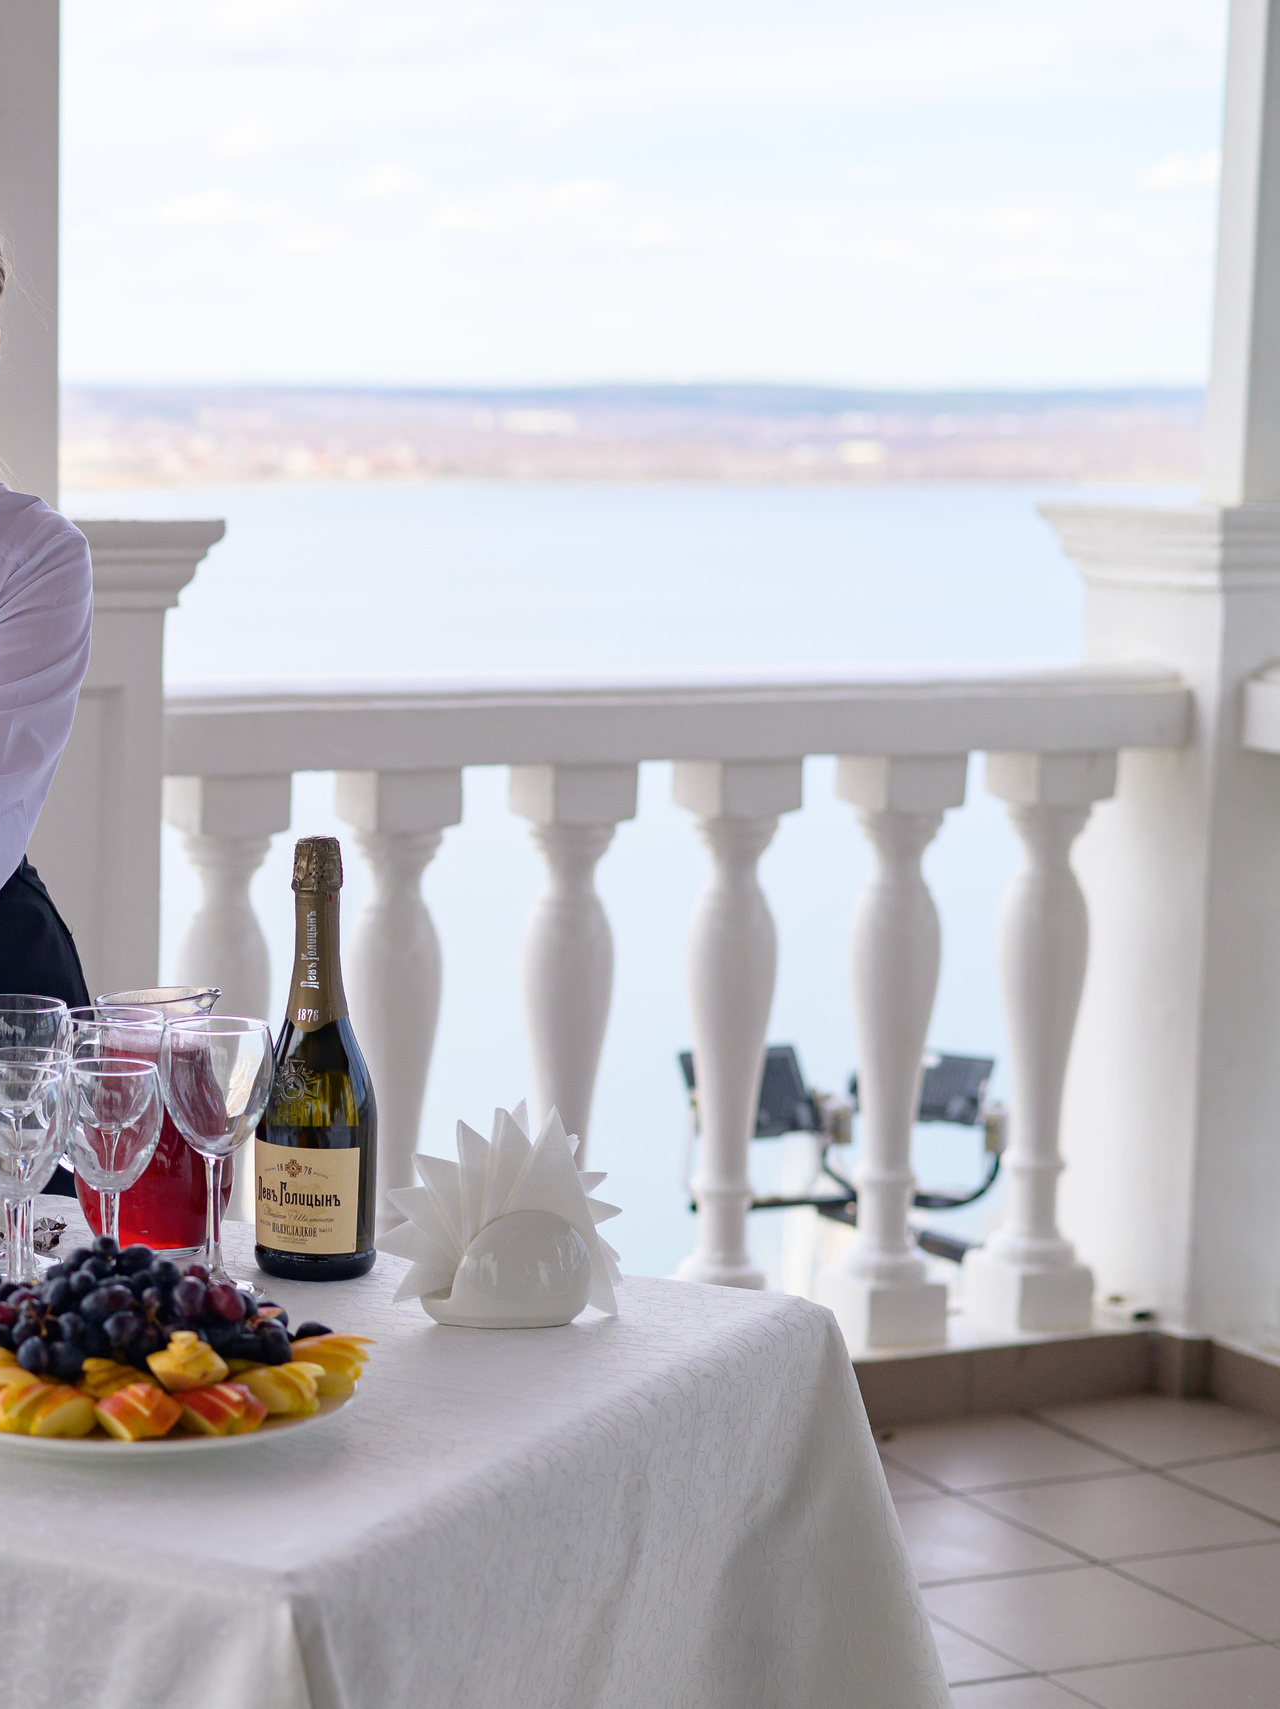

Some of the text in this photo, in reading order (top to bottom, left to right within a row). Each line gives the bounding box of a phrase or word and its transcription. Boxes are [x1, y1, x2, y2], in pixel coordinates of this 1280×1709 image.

[297, 1008, 319, 1023] 1876
[276, 1163, 284, 1172] 18
[303, 1165, 312, 1175] 76
[258, 1175, 341, 1208] Левъ Голицынъ
[272, 1222, 318, 1238] ПОЛУСЛАДКОЕ
